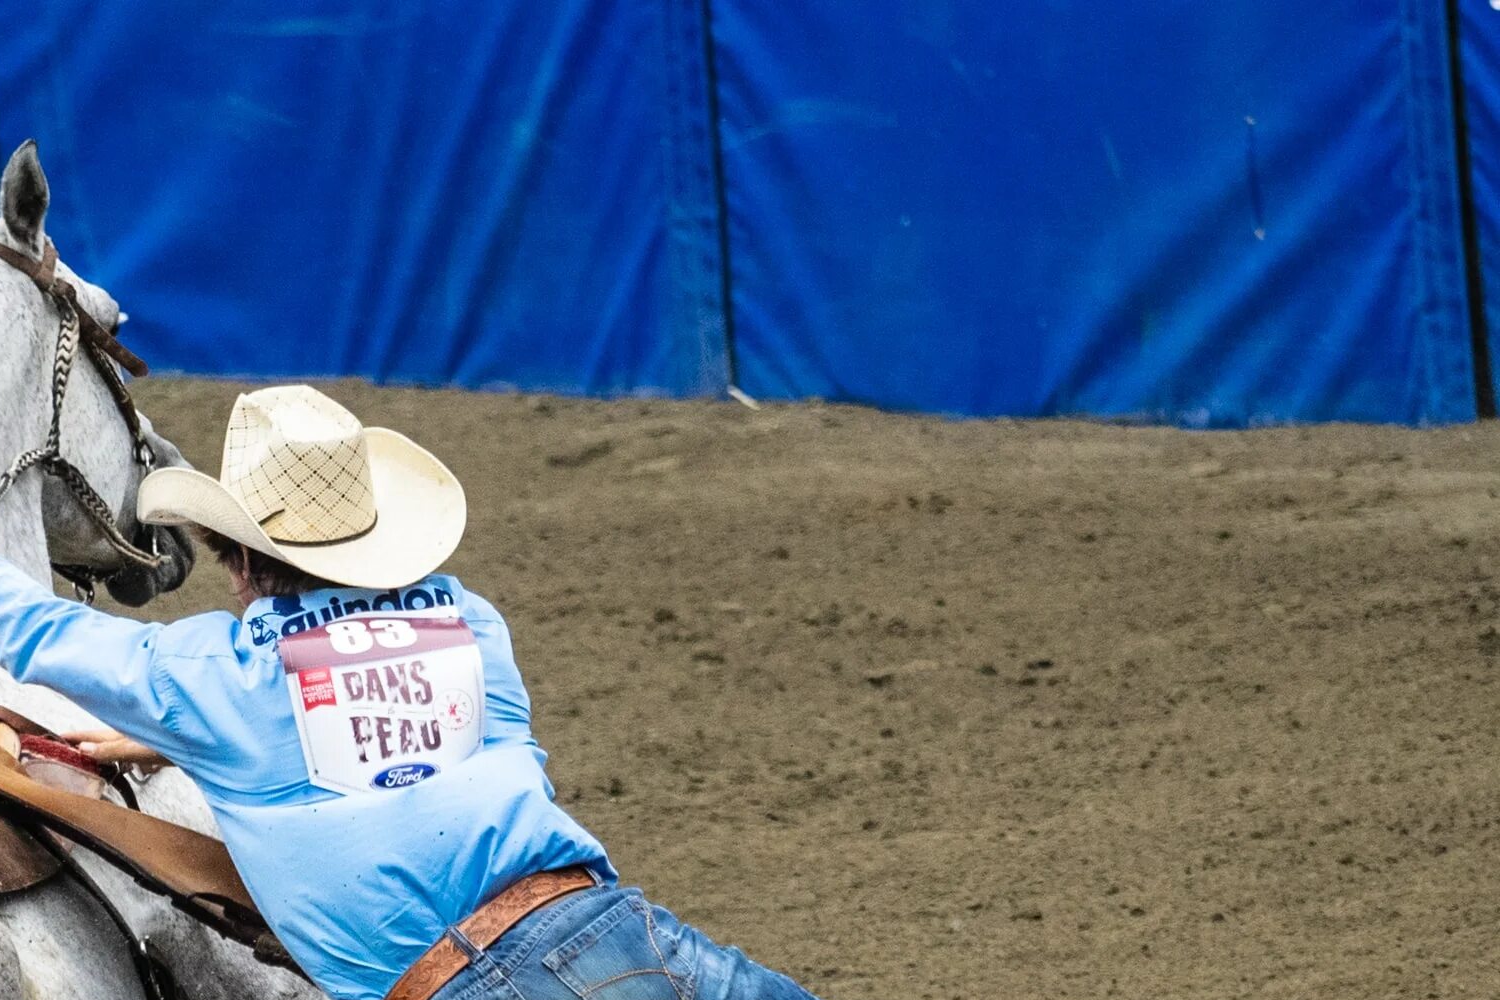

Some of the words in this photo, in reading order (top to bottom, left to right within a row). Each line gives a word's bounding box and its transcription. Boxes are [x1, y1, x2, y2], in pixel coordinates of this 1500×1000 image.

[325, 619, 418, 655] 83
[342, 659, 434, 707] DANS
[350, 716, 443, 763] PEAU
[385, 766, 425, 789] Ford
